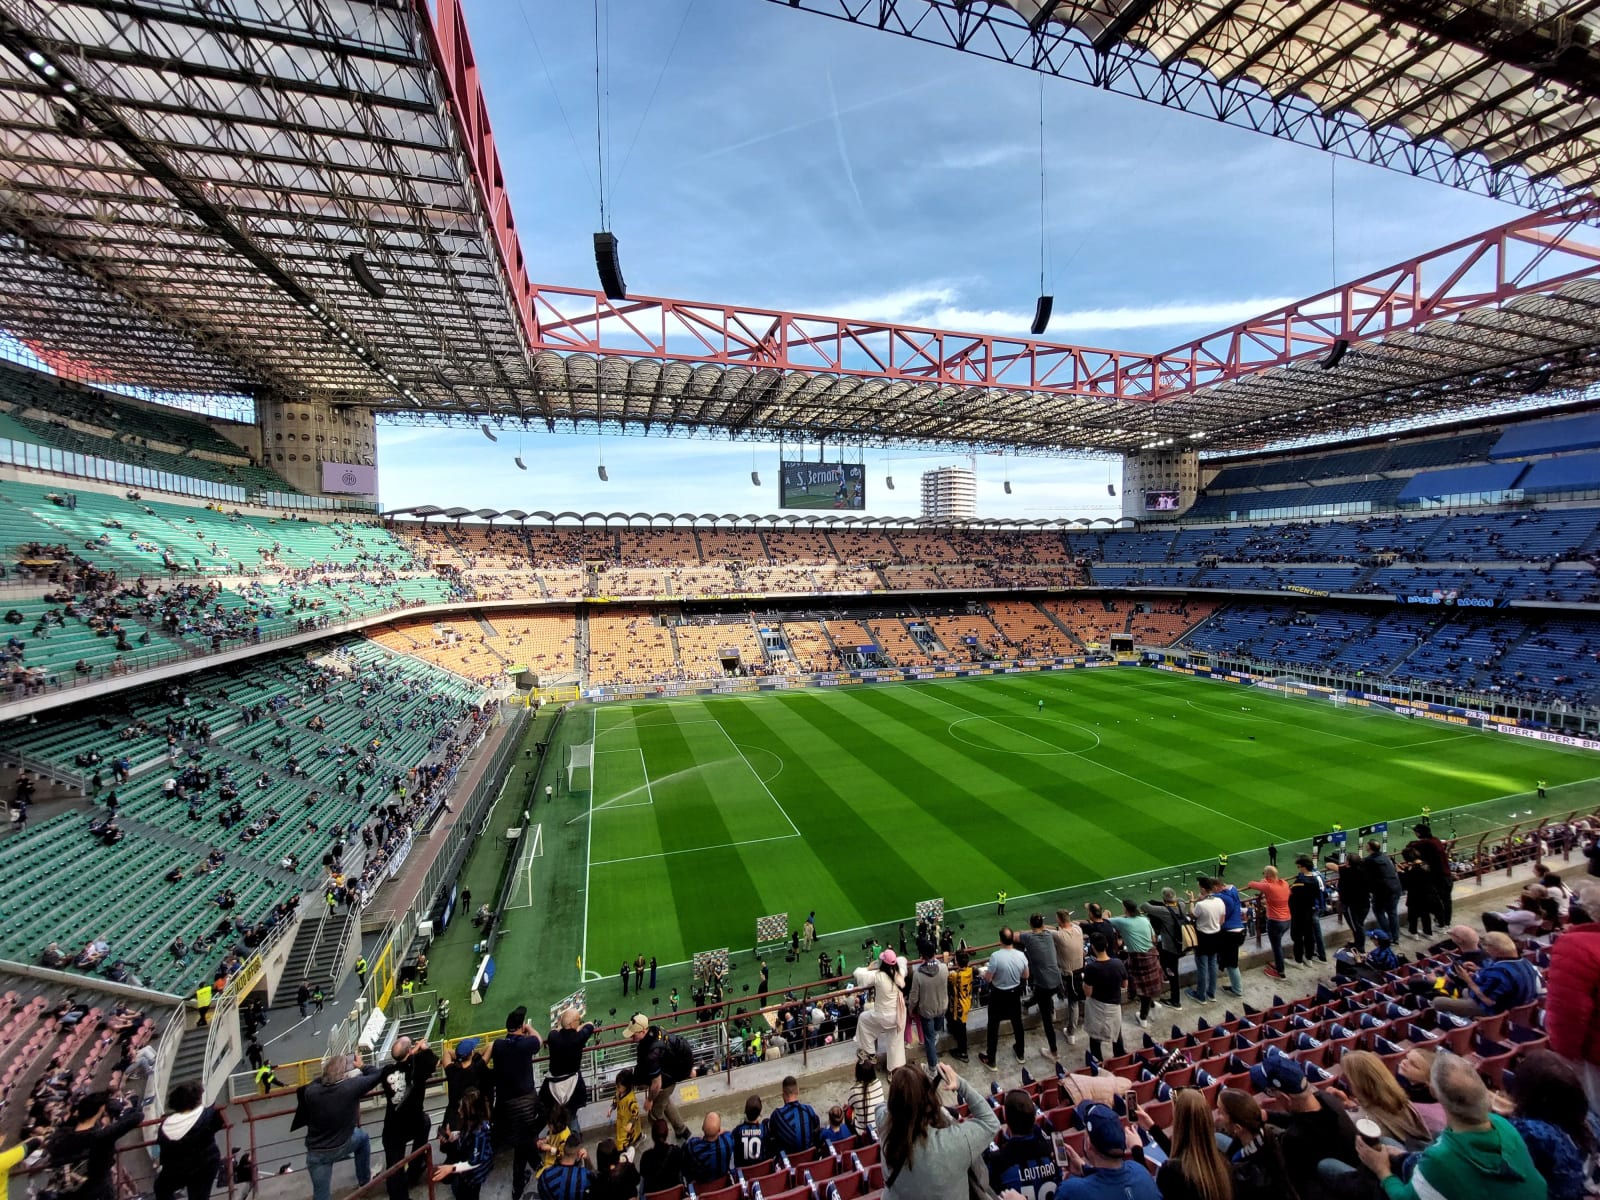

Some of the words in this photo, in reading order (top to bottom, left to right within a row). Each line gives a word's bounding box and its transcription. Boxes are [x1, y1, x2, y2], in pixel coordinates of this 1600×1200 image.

[1501, 725, 1534, 737] BPER:
[1540, 732, 1576, 745] BPER:
[1582, 740, 1600, 751] BP
[741, 1136, 762, 1160] 10
[1018, 1162, 1056, 1182] LAUTARO
